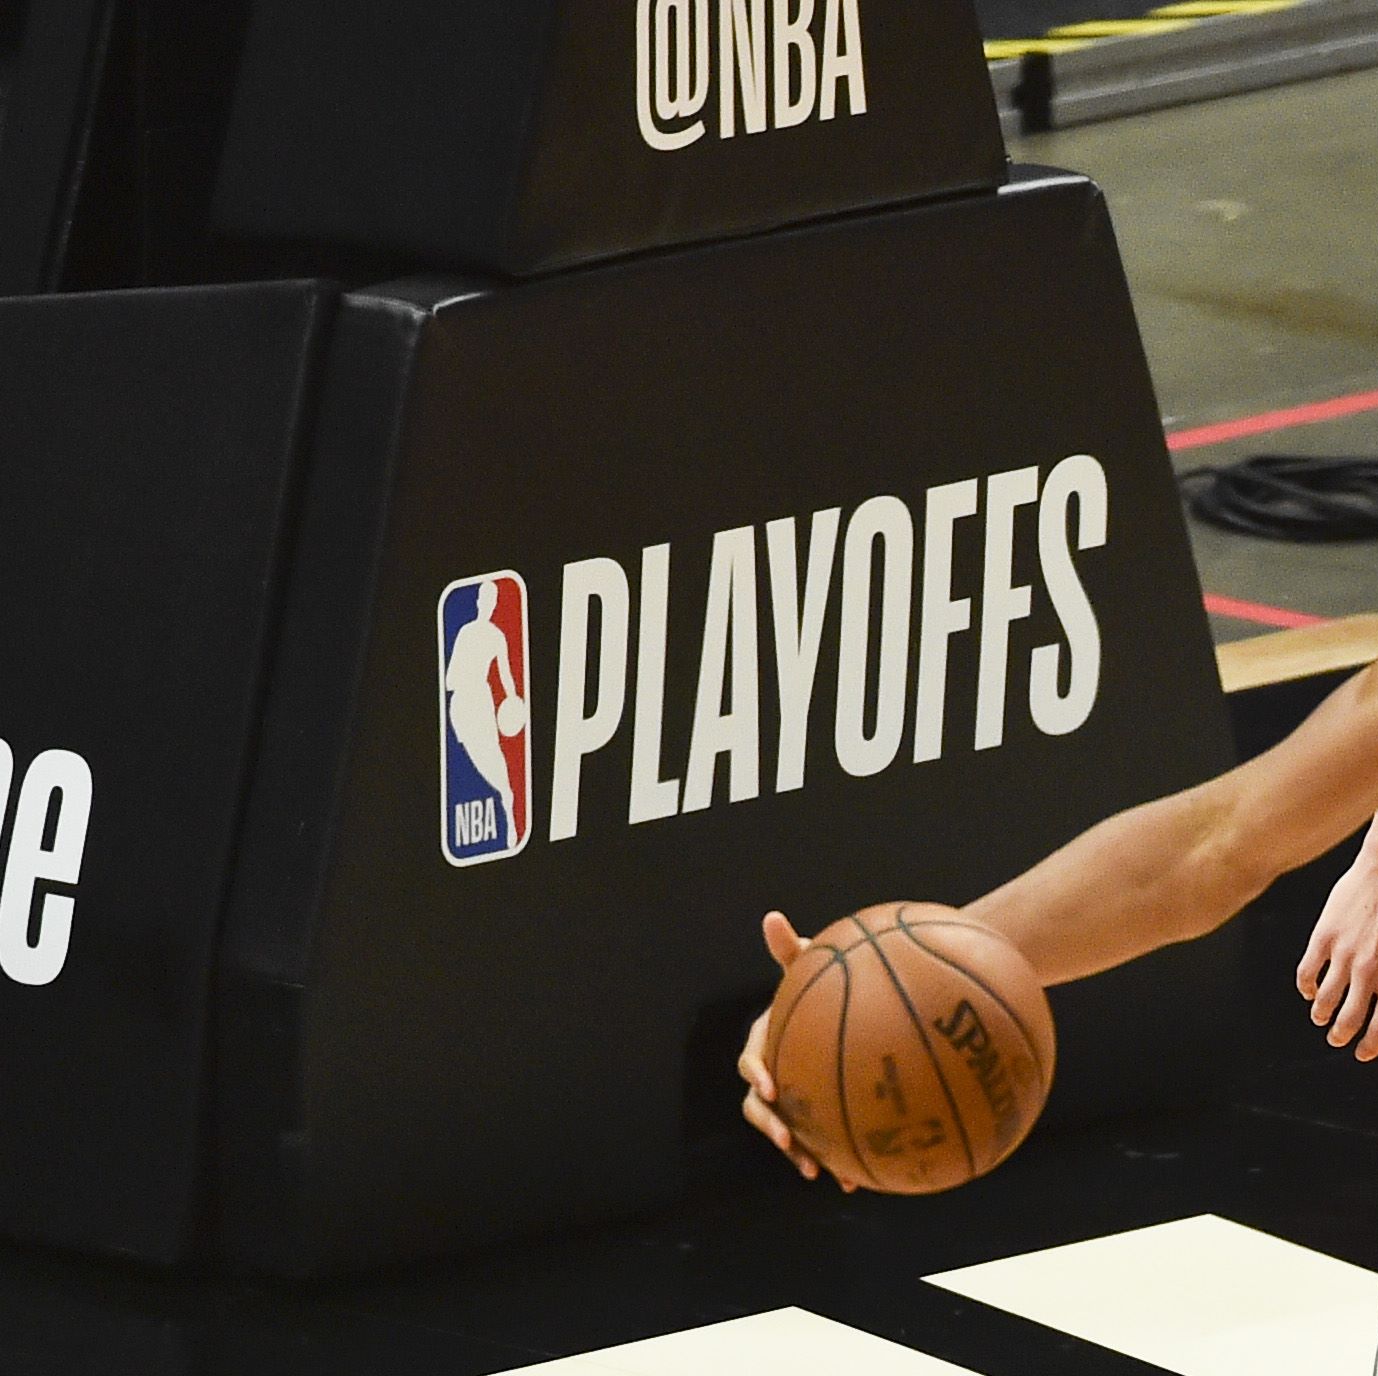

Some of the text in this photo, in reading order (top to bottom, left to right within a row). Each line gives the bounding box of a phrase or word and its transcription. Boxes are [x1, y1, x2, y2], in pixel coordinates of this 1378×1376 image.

[636, 0, 868, 152] @NBA
[548, 454, 1109, 842] PLAYOFFS
[0, 738, 93, 986] e
[454, 796, 498, 848] NBA
